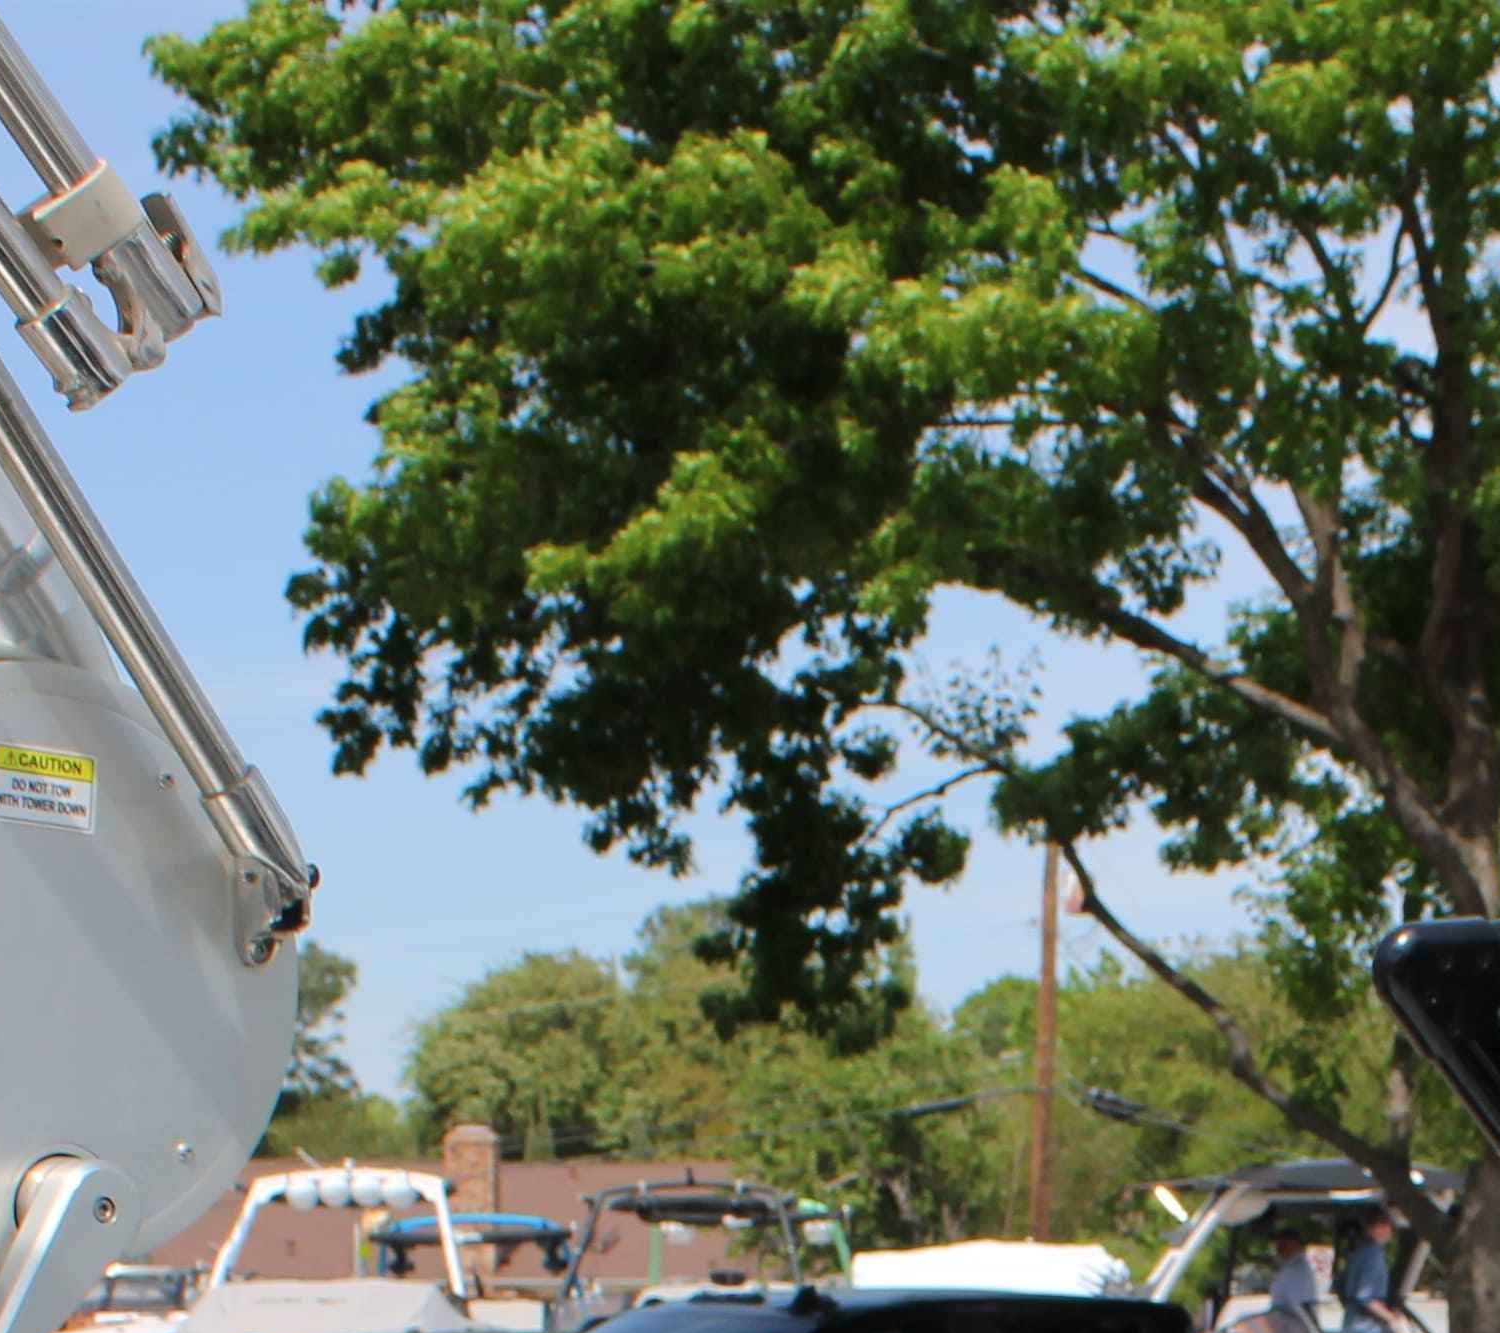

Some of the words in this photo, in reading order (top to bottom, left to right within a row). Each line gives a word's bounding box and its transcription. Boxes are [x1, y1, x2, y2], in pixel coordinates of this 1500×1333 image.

[18, 752, 83, 776] CAUTION
[11, 777, 27, 792] DO
[28, 780, 49, 796] NOT
[51, 782, 72, 799] TOW
[21, 795, 55, 813] TOWER
[57, 801, 87, 817] DOWN
